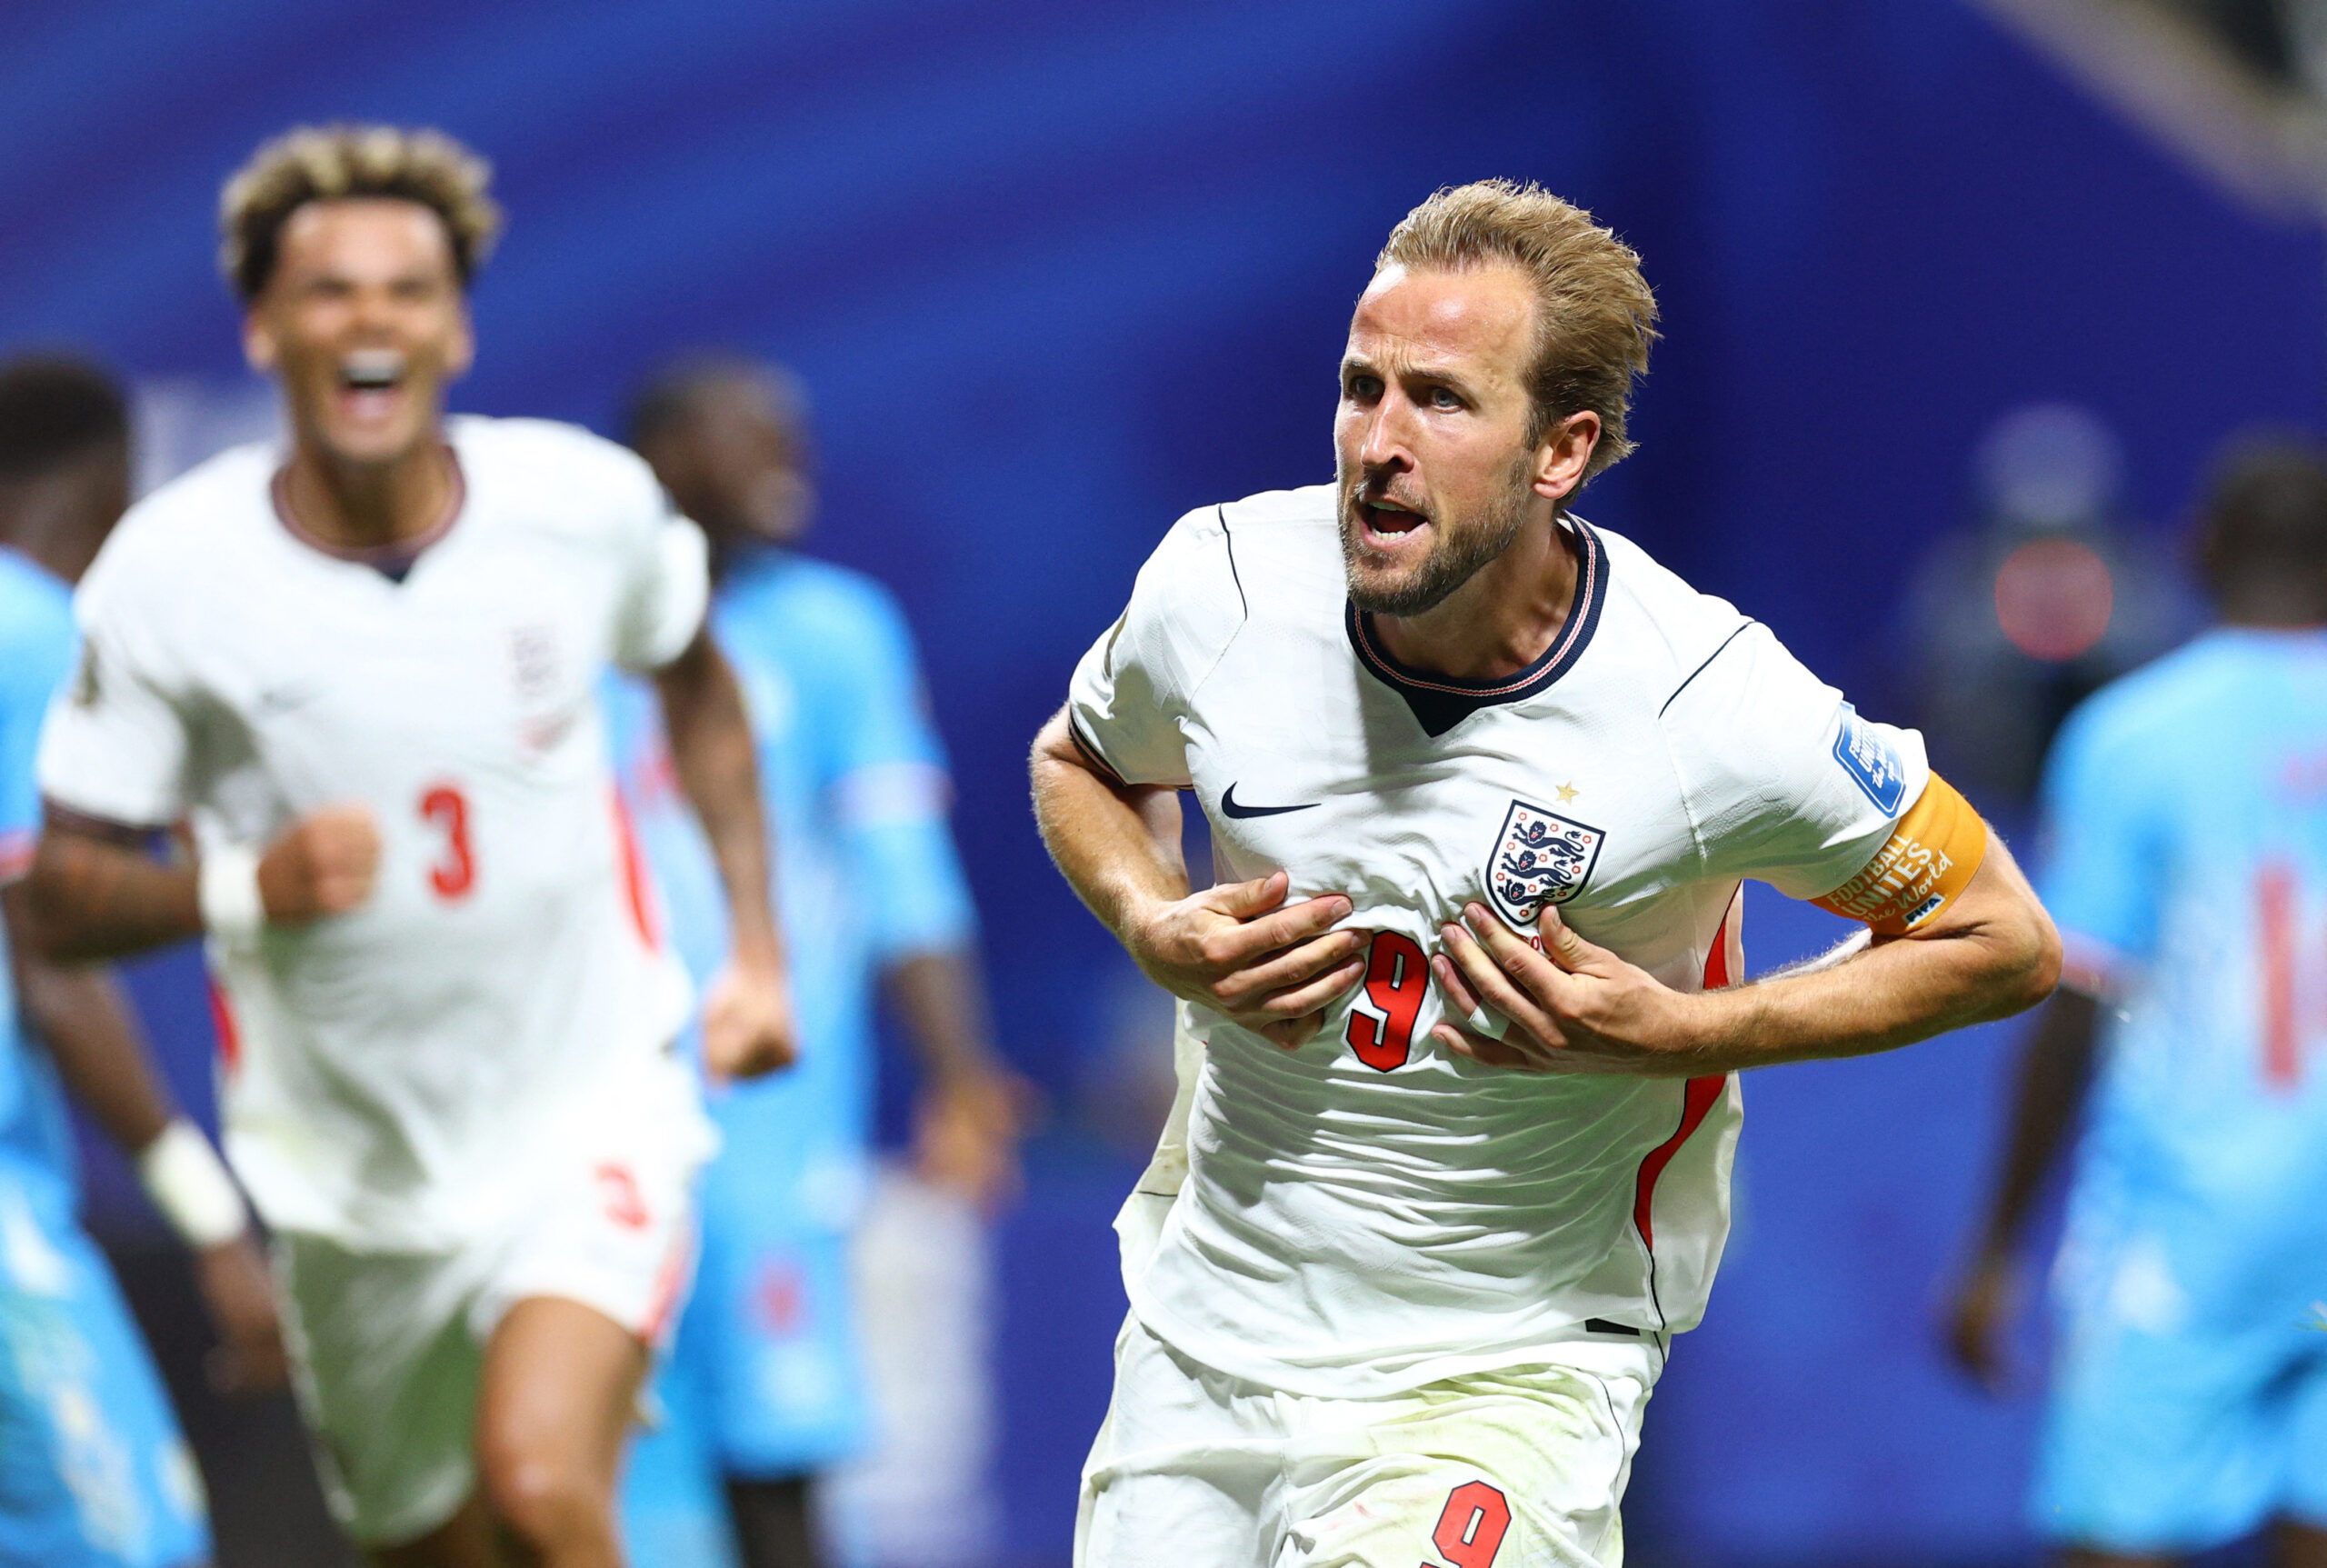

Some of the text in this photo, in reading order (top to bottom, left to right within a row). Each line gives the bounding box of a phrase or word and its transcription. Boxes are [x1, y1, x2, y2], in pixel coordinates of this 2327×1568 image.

[420, 786, 474, 897] 3
[1826, 834, 1913, 906] FOOTBALL
[1841, 842, 1933, 916] UNITES
[1863, 849, 1953, 922] the World
[1905, 897, 1942, 923] FIFA
[1346, 930, 1430, 1074] 9
[593, 1161, 650, 1233] 3
[1419, 1480, 1512, 1568] 9
